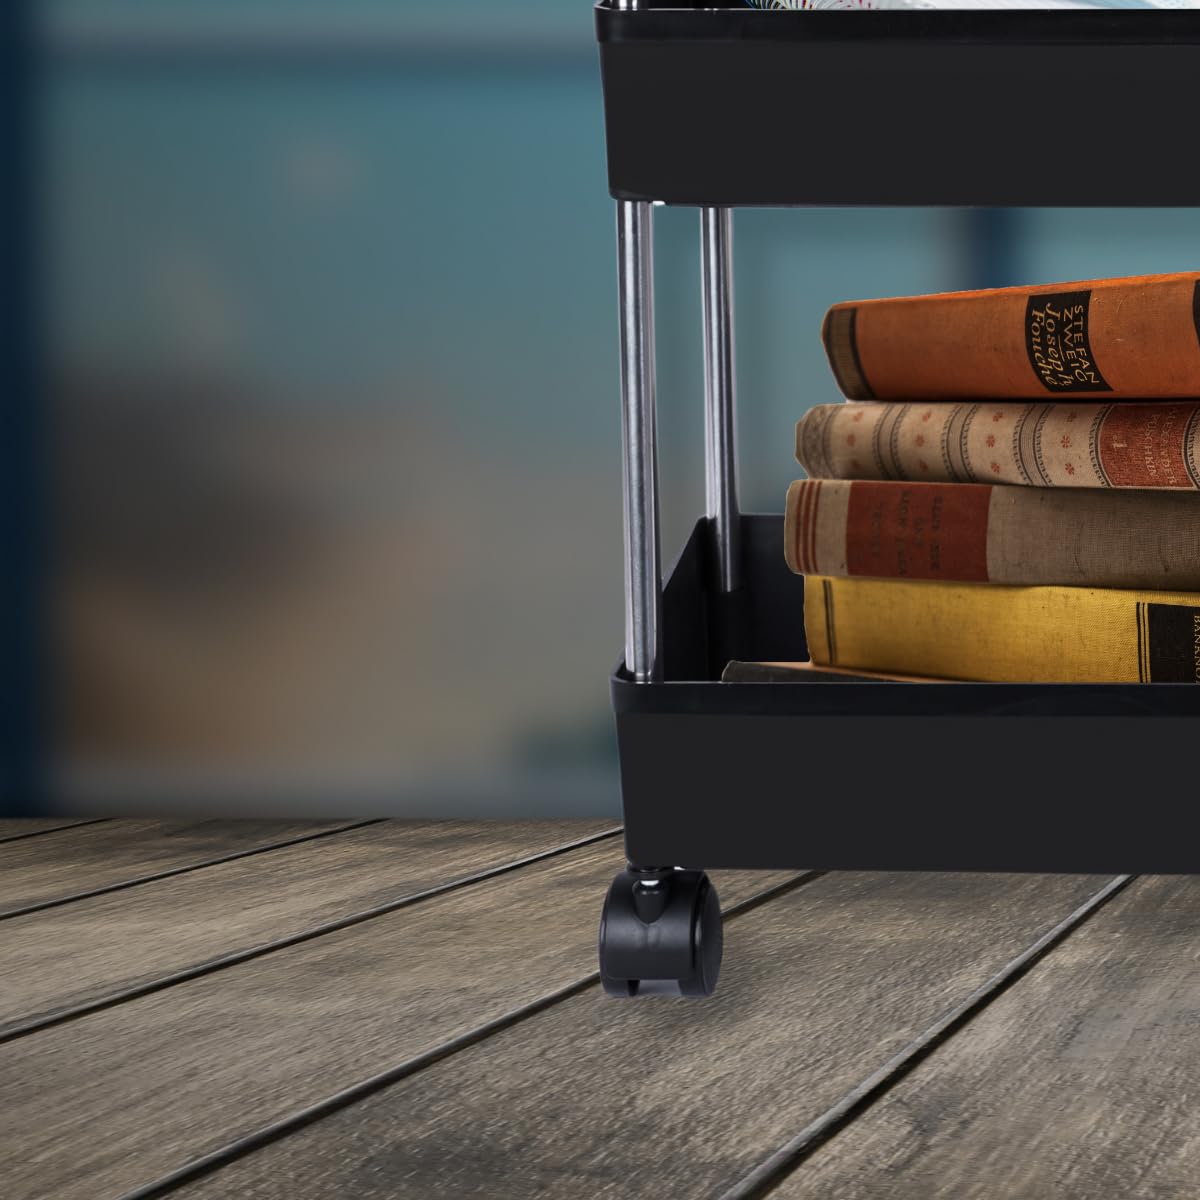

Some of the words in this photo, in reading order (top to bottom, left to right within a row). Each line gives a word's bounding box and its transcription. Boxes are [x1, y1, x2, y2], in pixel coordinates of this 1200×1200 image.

[1045, 302, 1074, 386] Joseph
[1063, 307, 1088, 382] ZWEIG
[1074, 305, 1100, 384] STEFAN
